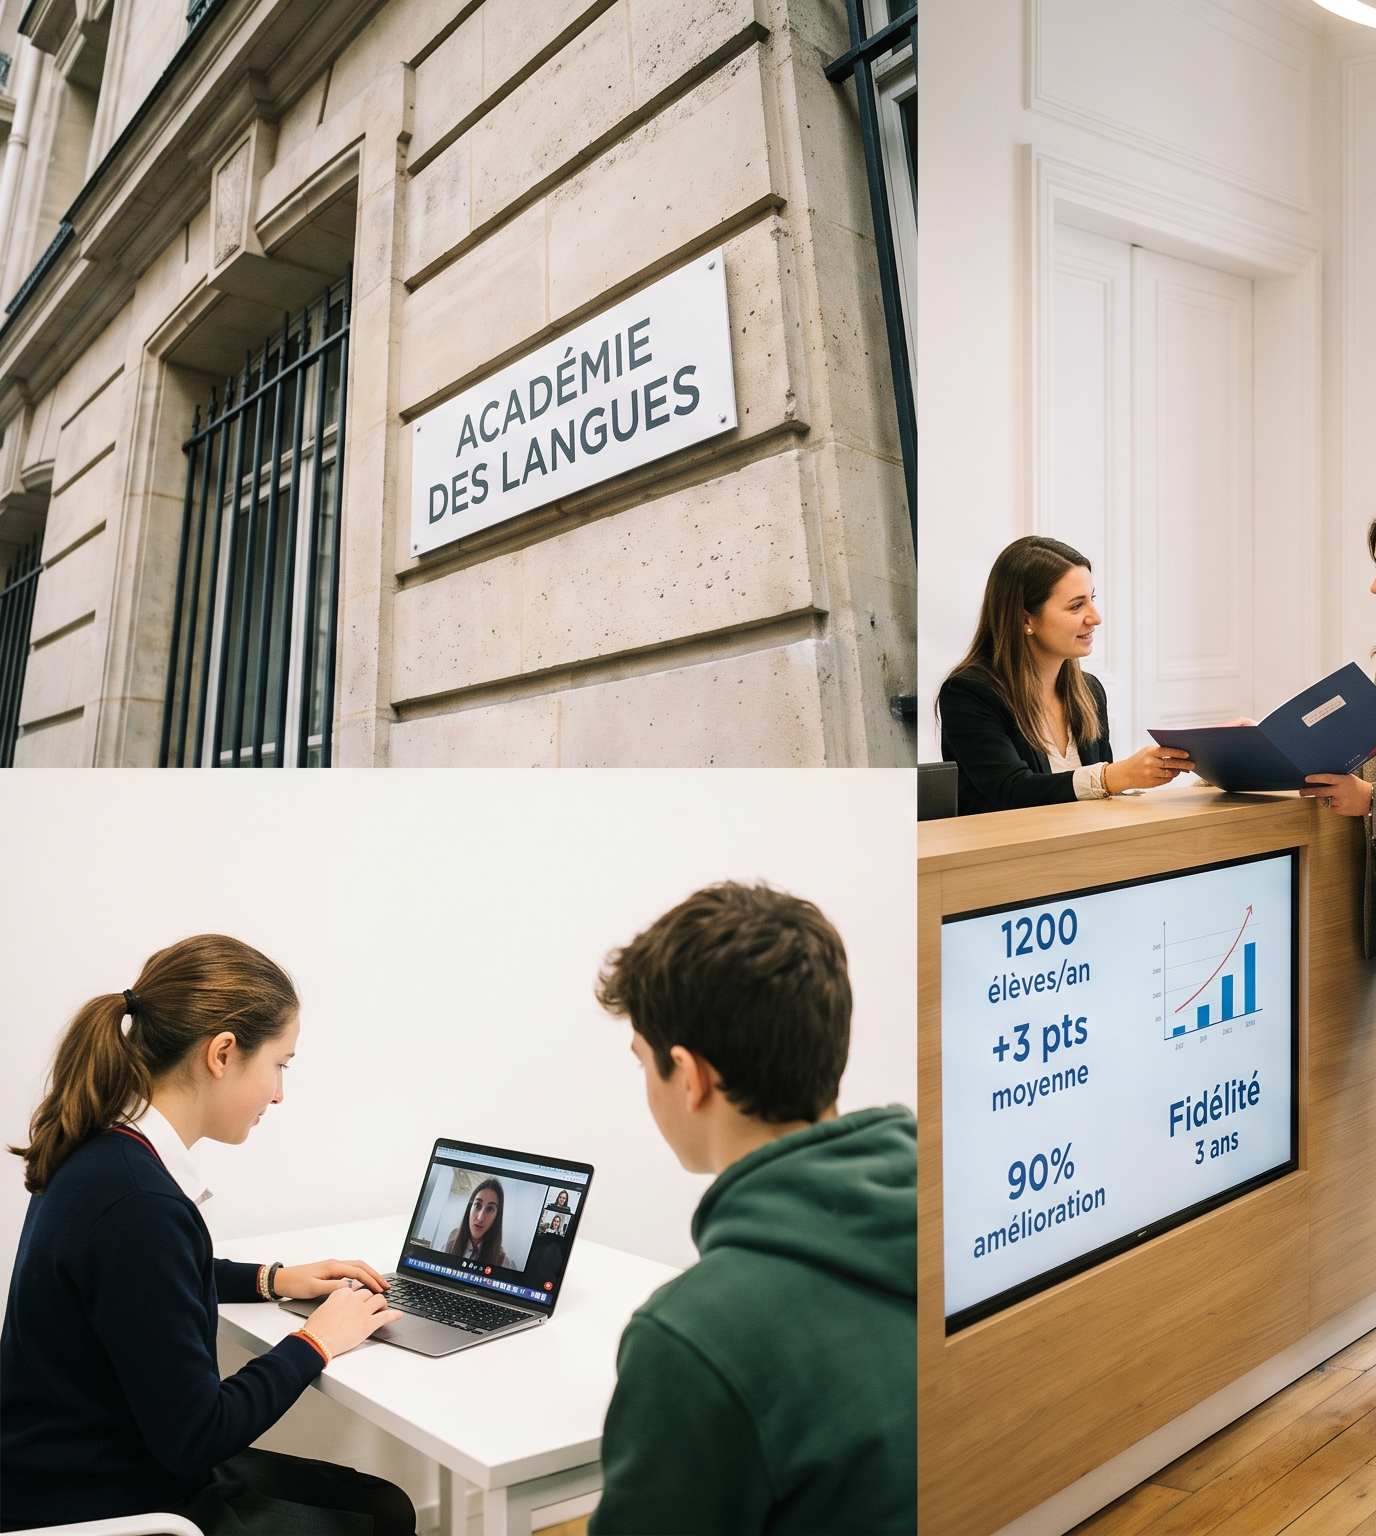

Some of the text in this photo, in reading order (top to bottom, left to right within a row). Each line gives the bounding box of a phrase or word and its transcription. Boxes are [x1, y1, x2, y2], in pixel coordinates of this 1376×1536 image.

[456, 317, 652, 457] ACADÉMIE
[429, 365, 701, 524] DES LANGUES
[1001, 908, 1078, 958] 1200
[988, 958, 1091, 1004] élèves/an
[992, 1013, 1088, 1063] +3 pts
[992, 1063, 1089, 1111] moyenne
[1169, 1070, 1261, 1137] Fidélité
[1008, 1142, 1075, 1200] 90%
[1195, 1129, 1239, 1165] 3 ans
[973, 1186, 1106, 1258] amélioration
